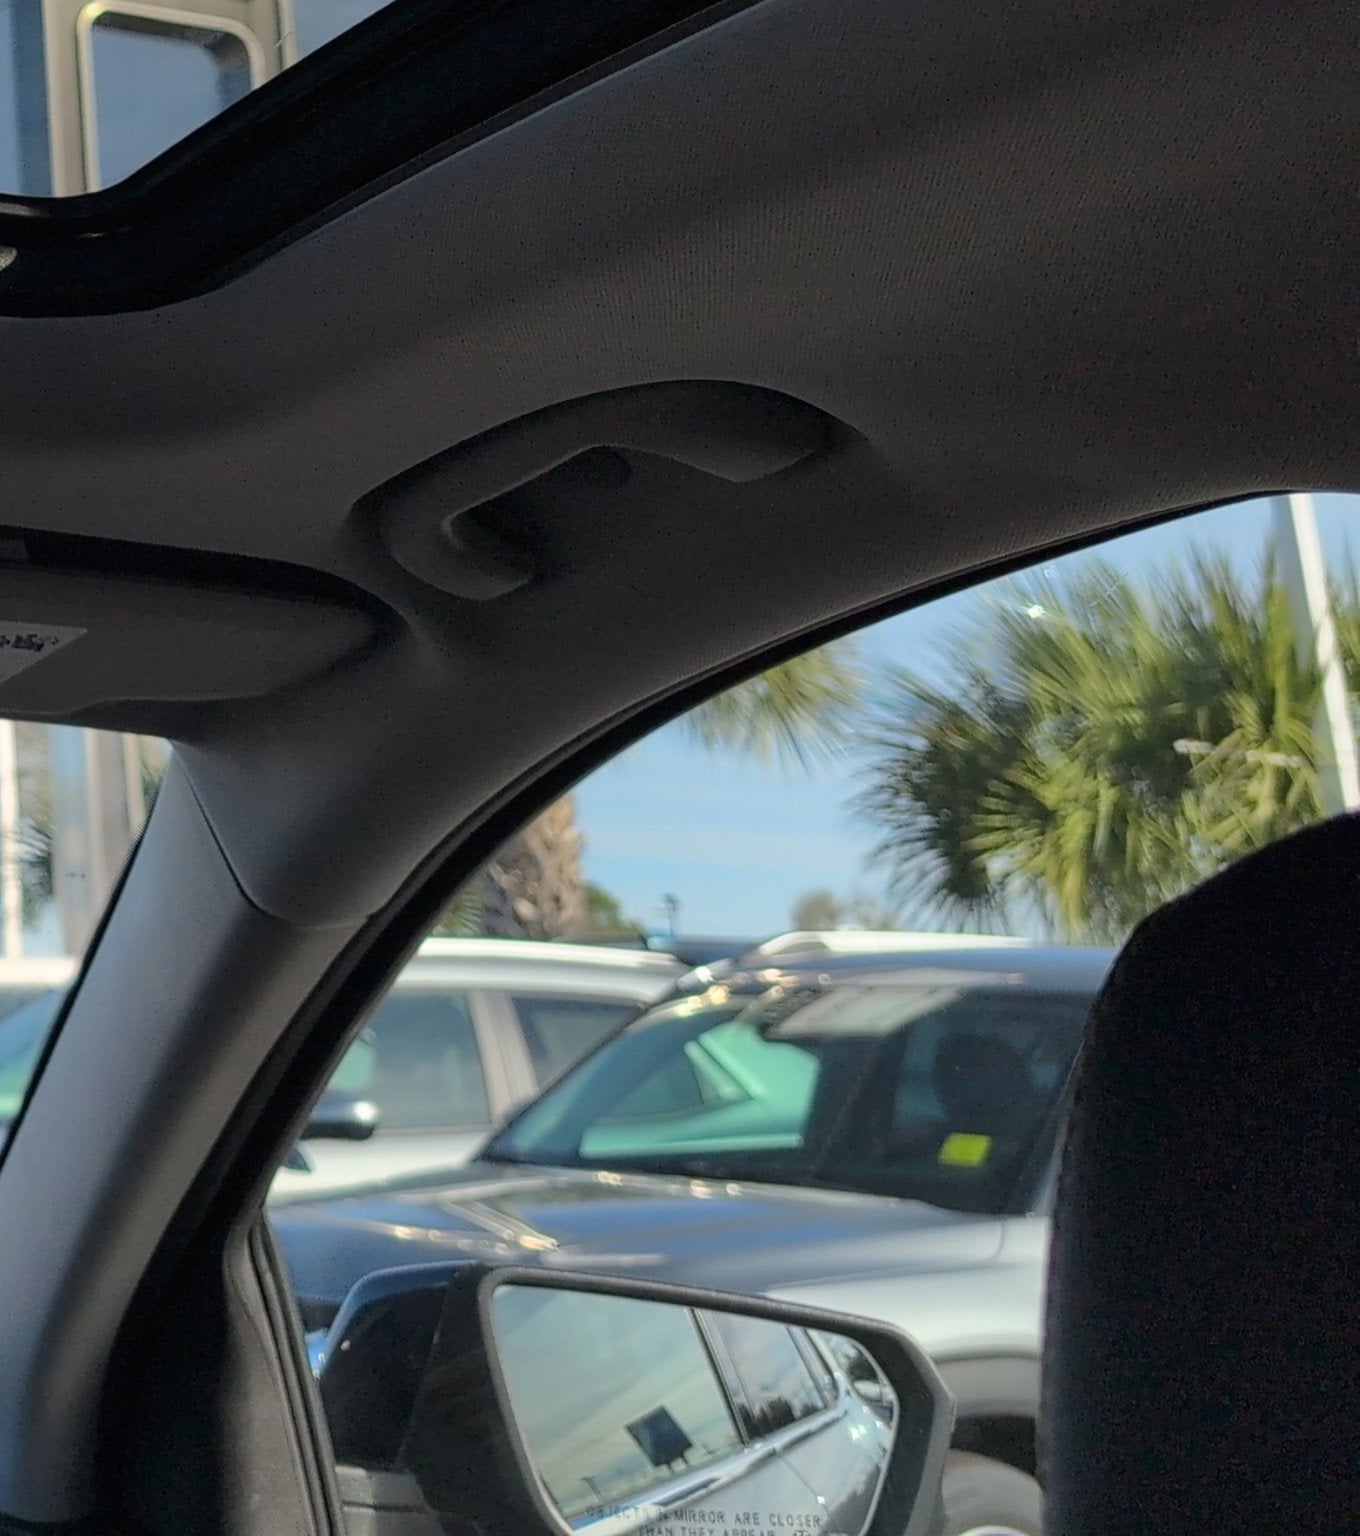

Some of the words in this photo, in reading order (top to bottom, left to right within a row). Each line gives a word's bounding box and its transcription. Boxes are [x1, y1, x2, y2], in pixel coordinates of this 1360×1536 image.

[673, 1509, 725, 1524] MIRROR
[734, 1512, 761, 1526] ARE
[768, 1513, 821, 1528] CLOSER
